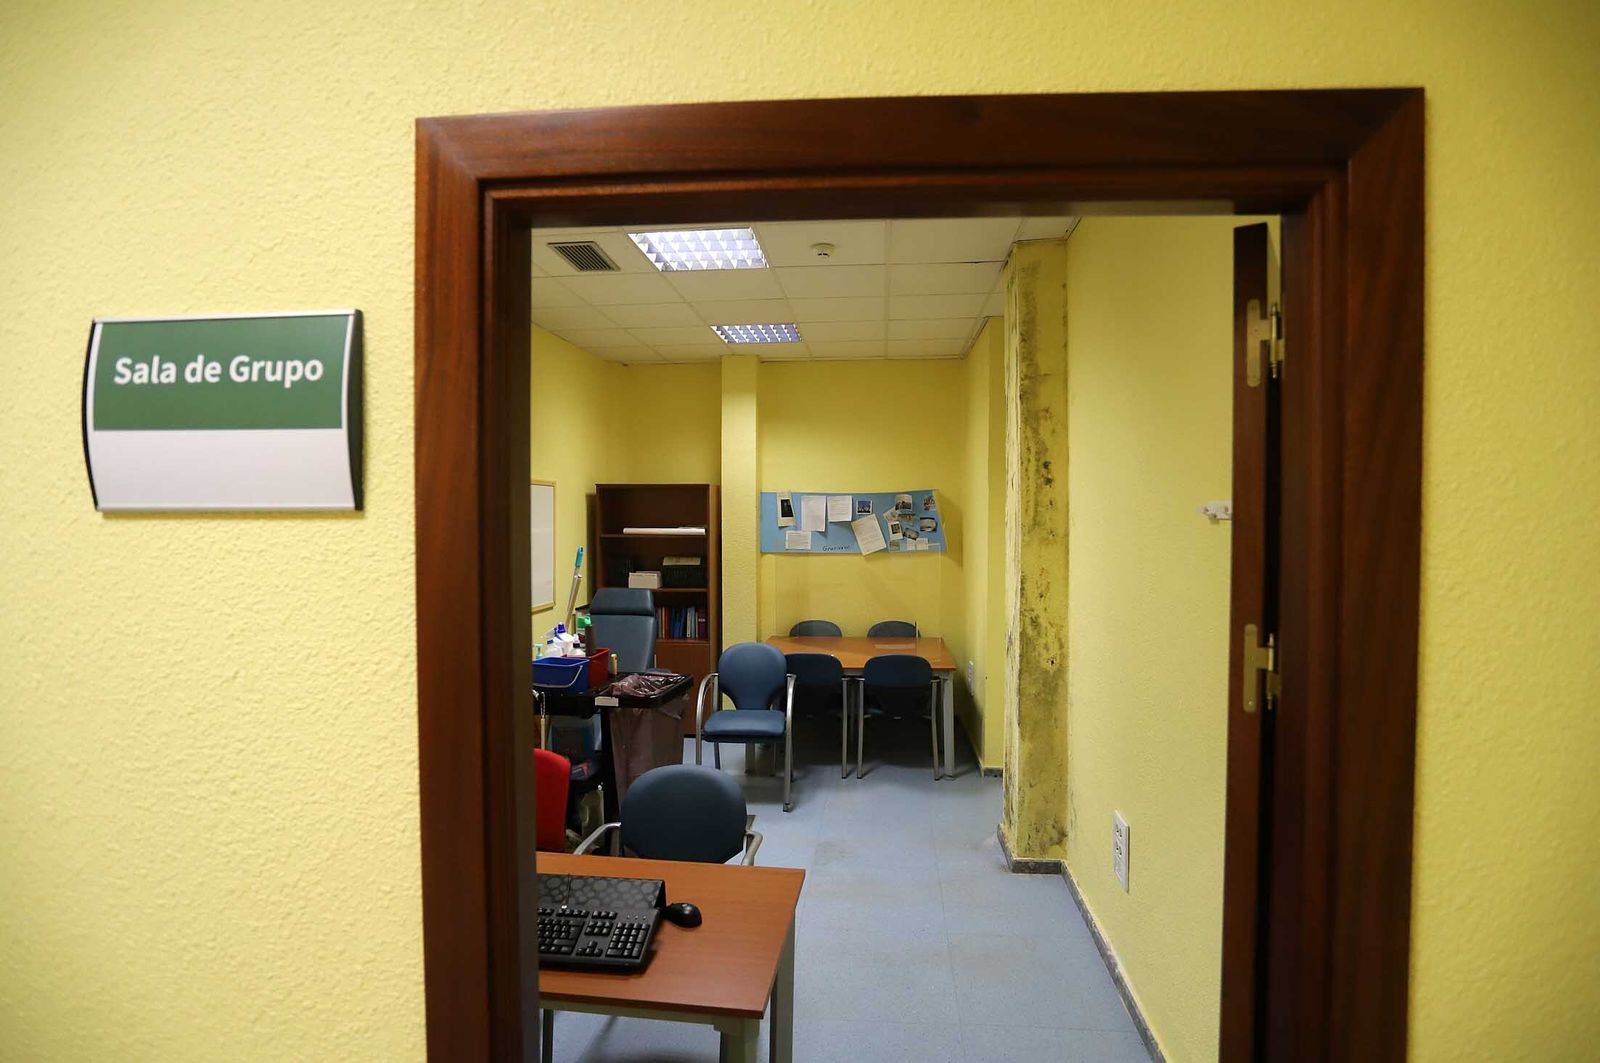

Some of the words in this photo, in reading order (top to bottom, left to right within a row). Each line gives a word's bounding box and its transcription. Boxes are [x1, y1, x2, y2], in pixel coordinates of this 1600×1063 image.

[114, 355, 177, 385] Sala
[184, 354, 222, 383] de
[229, 355, 324, 388] Grupo
